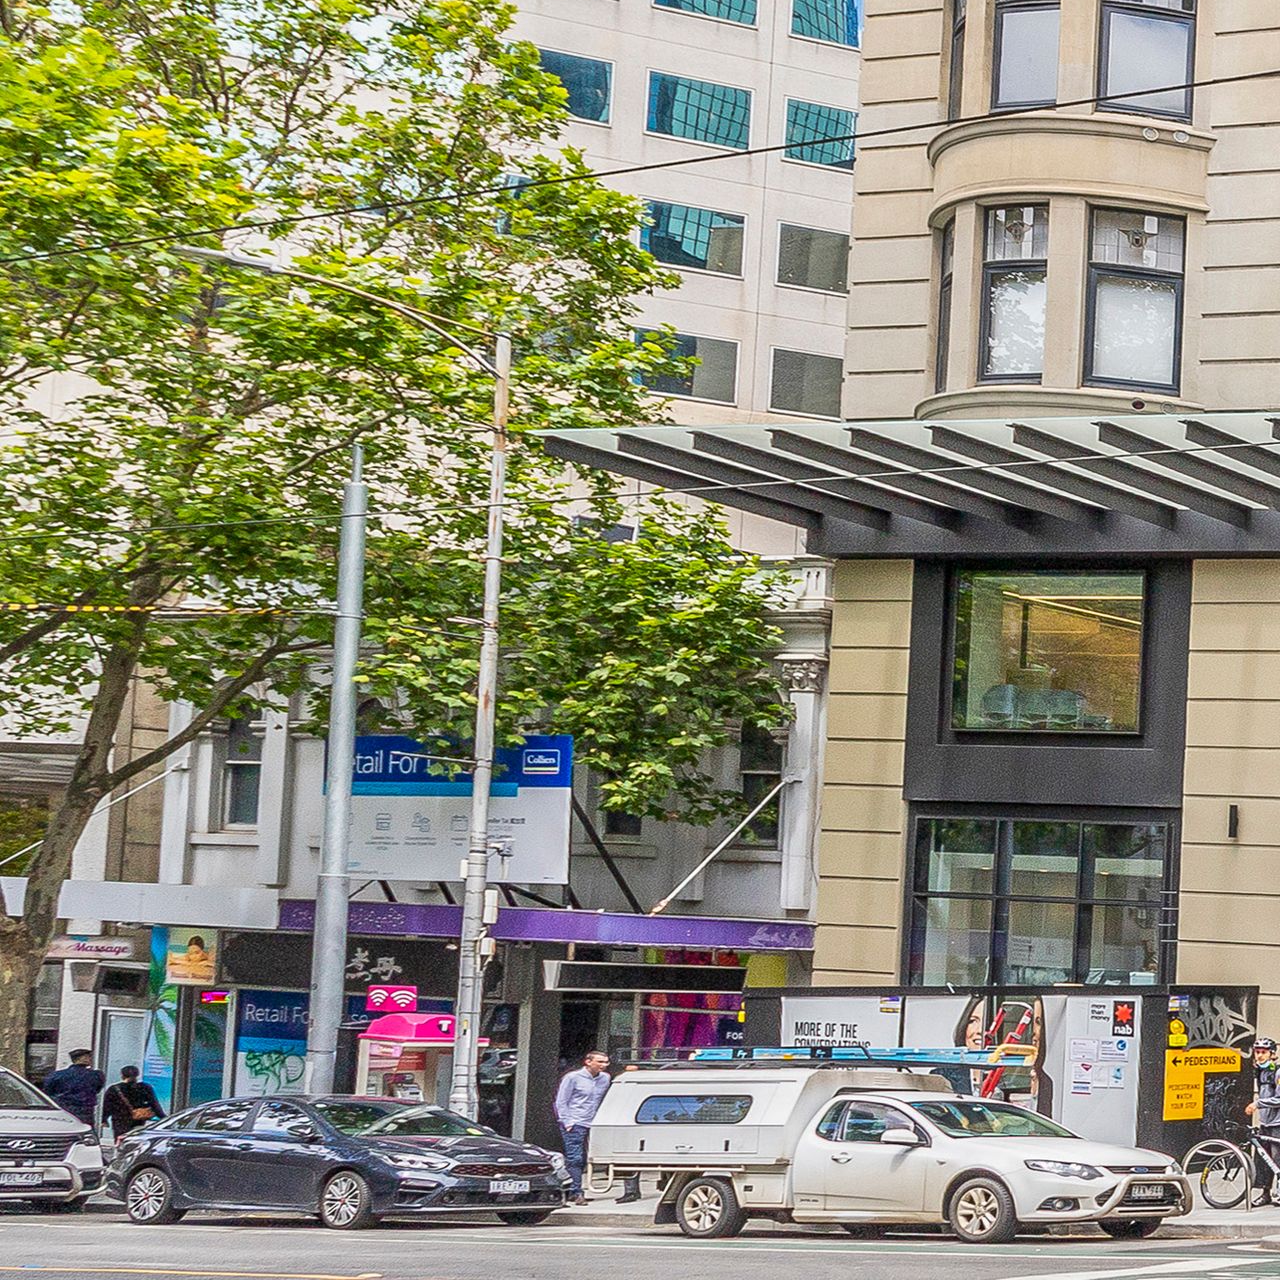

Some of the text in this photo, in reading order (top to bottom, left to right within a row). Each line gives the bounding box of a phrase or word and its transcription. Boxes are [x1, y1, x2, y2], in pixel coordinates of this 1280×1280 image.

[389, 752, 420, 775] For
[526, 754, 557, 765] Colliers
[68, 941, 129, 956] Massage
[245, 1003, 311, 1024] Retail Fo
[1090, 1015, 1111, 1023] money
[794, 1022, 858, 1039] MORE OF THE
[1113, 1024, 1133, 1035] nab
[1183, 1055, 1237, 1066] PEDESTRIANS
